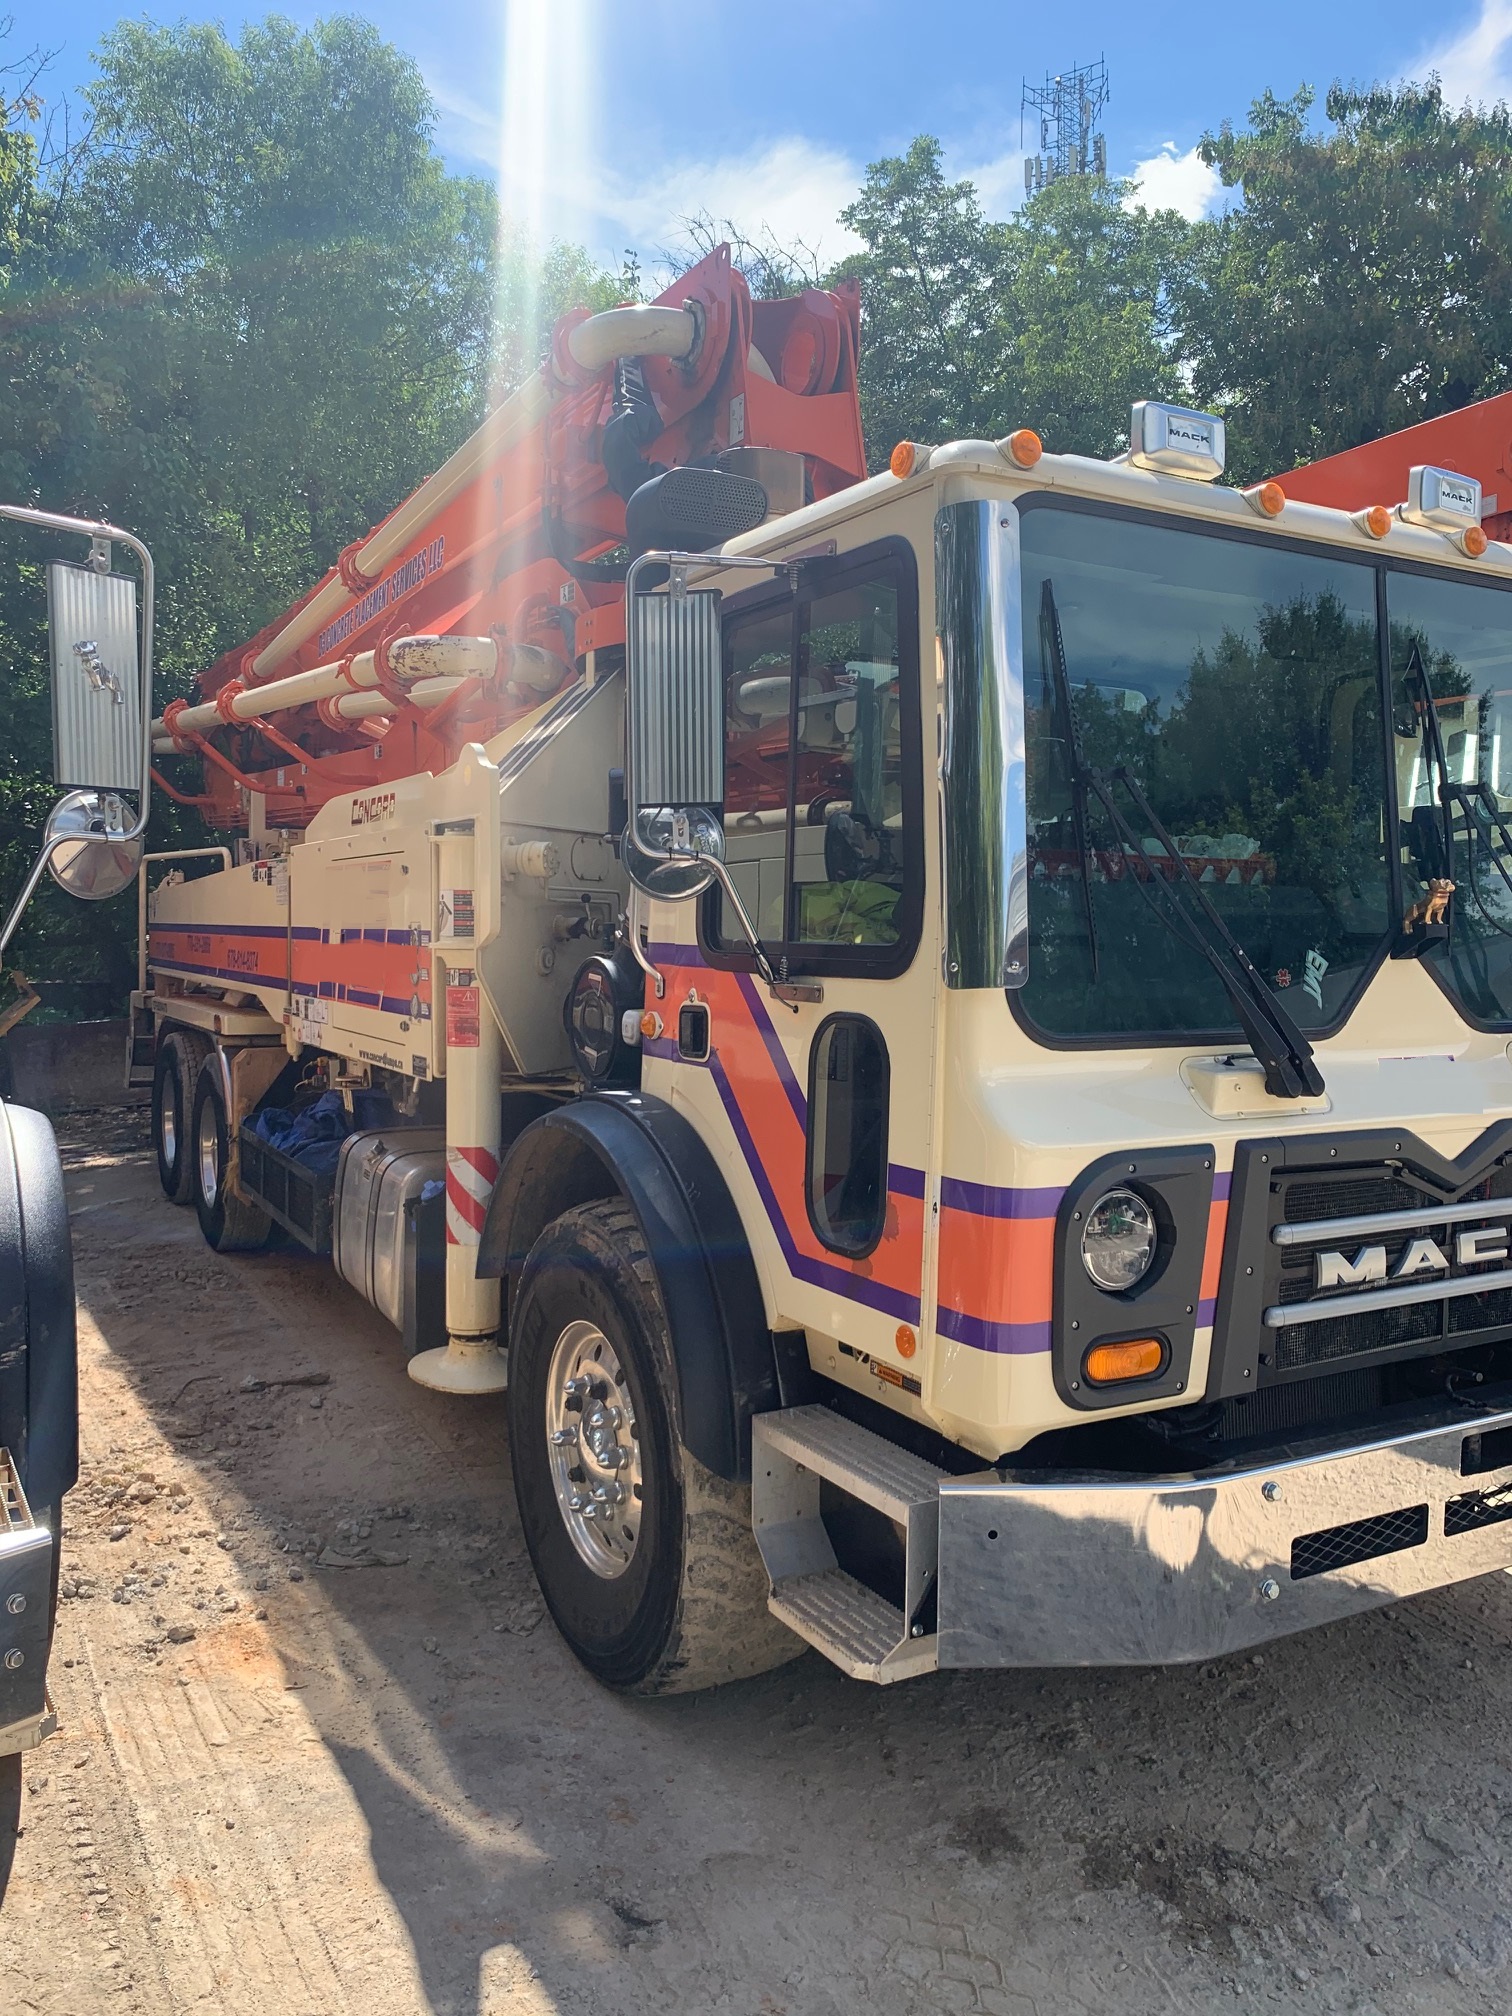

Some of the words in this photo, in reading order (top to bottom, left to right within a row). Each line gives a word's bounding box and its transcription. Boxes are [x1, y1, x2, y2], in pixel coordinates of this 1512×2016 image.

[1169, 428, 1210, 444] MACK
[1442, 490, 1473, 505] MACK
[326, 606, 355, 653] CONCRETE
[355, 576, 392, 631] PLACEMENT
[392, 547, 427, 603] SERVICES
[428, 535, 445, 576] LLC
[1303, 949, 1330, 1011] EMT
[1318, 1226, 1508, 1289] MAC
